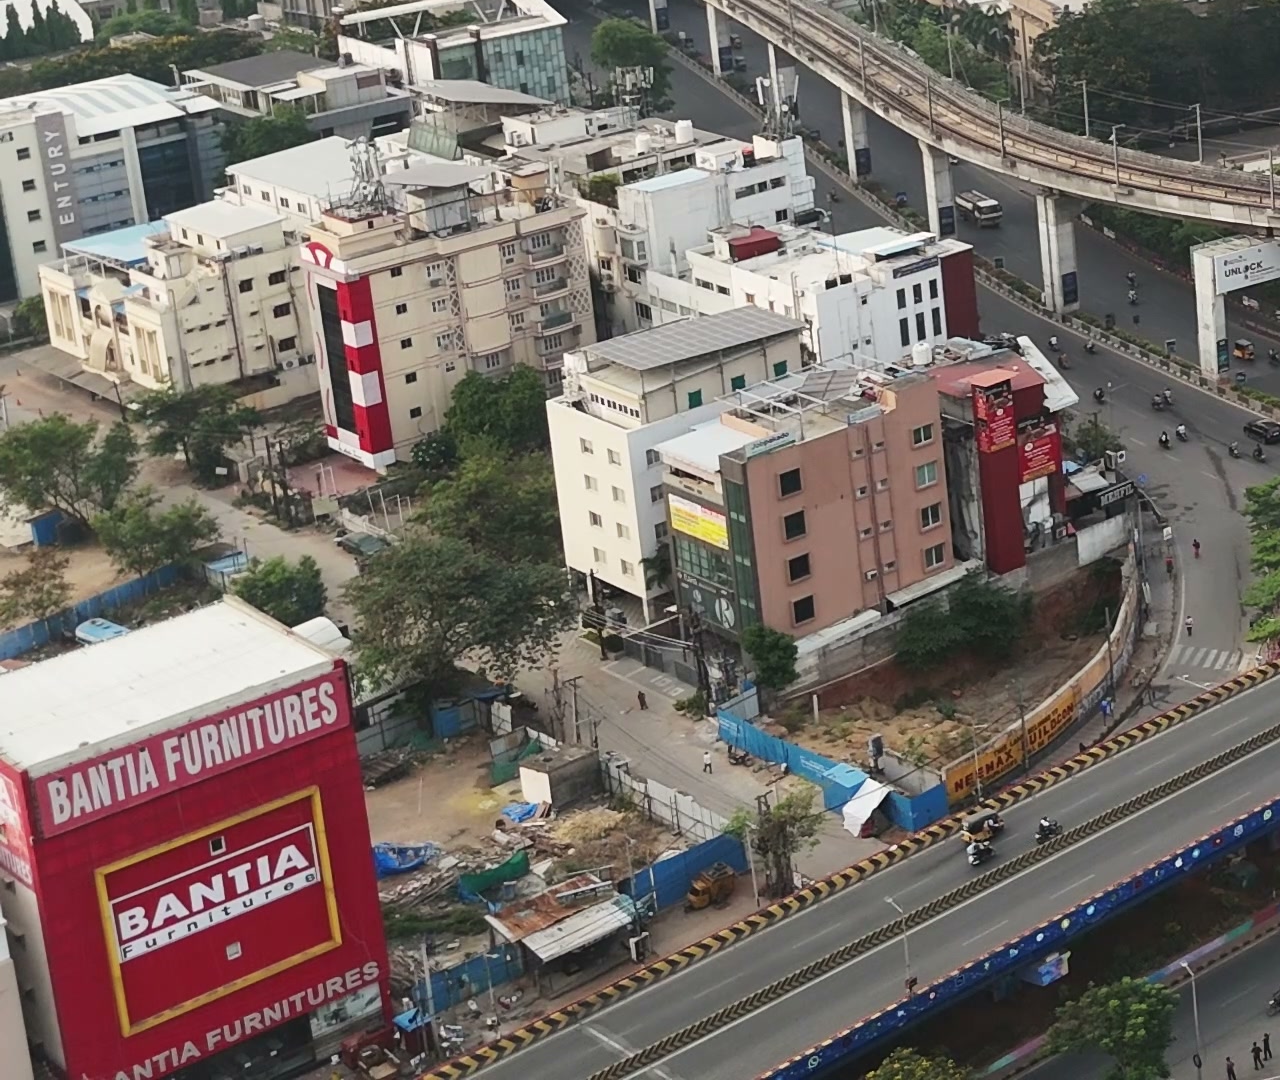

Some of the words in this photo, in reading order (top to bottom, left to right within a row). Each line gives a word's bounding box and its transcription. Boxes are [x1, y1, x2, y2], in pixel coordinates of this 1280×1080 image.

[44, 131, 75, 225] ENTURY
[1100, 483, 1135, 507] MEHFIL
[48, 747, 159, 825] BANTIA
[162, 682, 338, 781] FURNITURES
[118, 844, 309, 941] BANTIA
[122, 873, 316, 959] Furnitures
[206, 961, 379, 1051] FURNITURES
